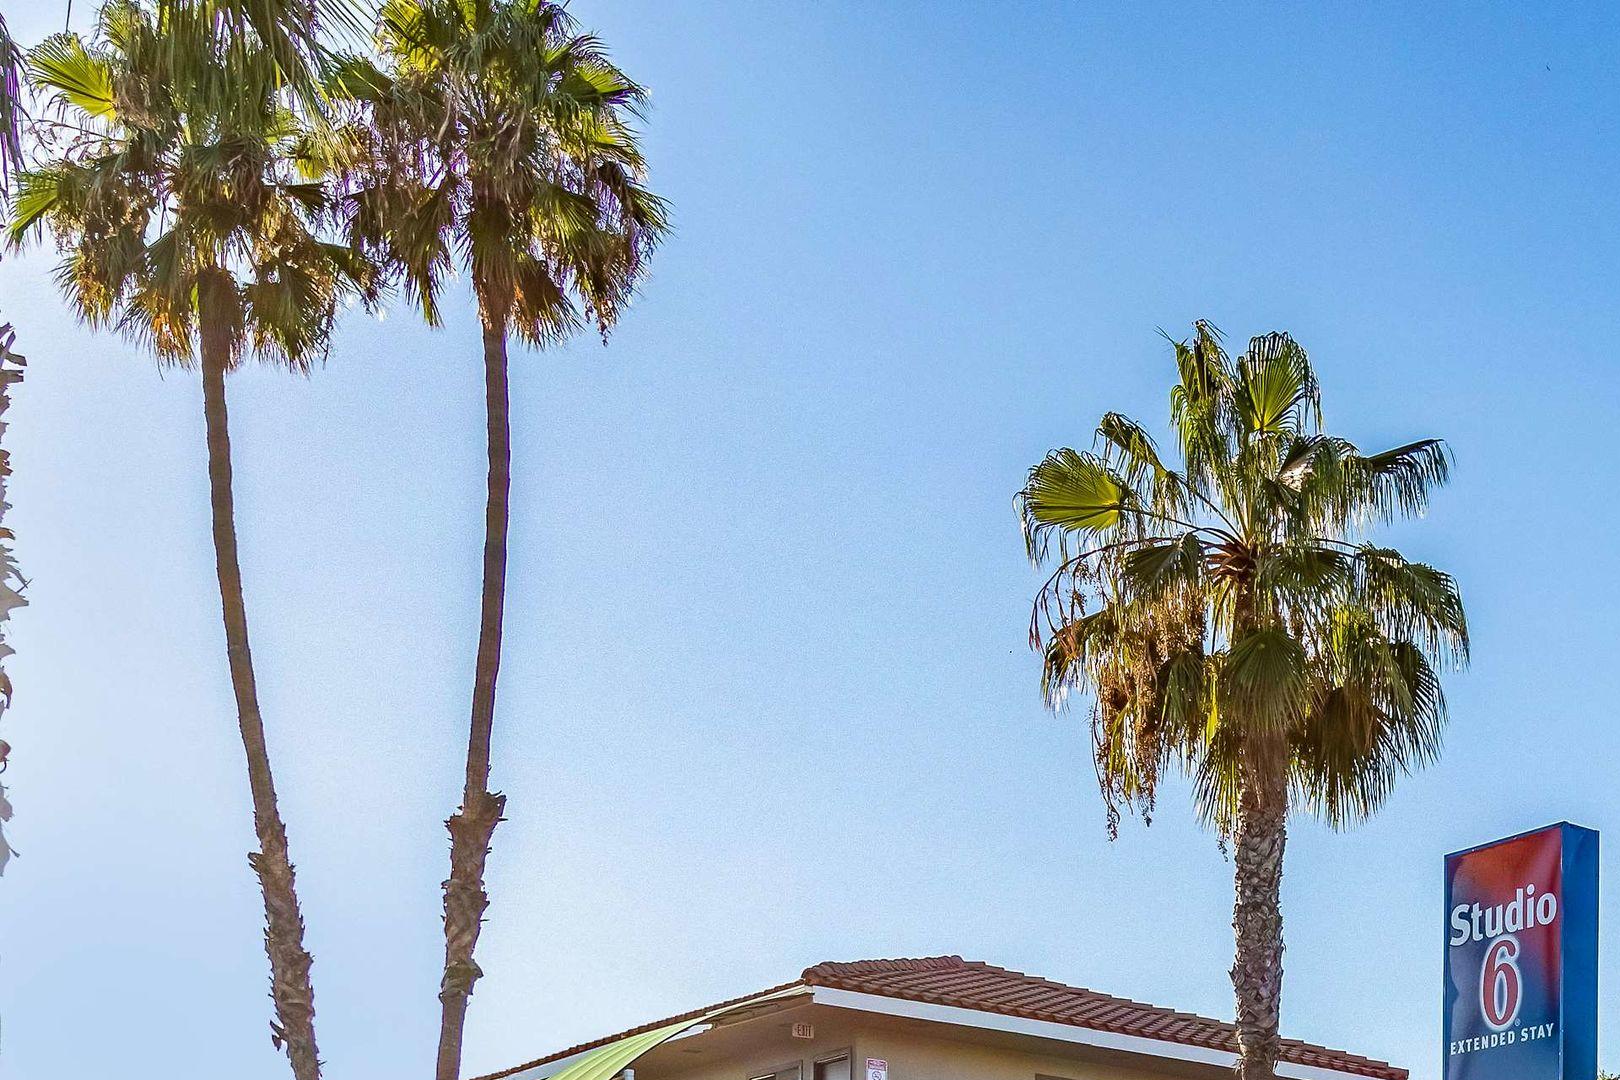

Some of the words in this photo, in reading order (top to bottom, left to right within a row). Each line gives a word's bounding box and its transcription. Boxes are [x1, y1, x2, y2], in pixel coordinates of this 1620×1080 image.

[1450, 884, 1557, 946] Studio
[1481, 936, 1521, 1031] 6
[1451, 1030, 1515, 1056] EXTENDED
[1521, 1023, 1554, 1042] STAY
